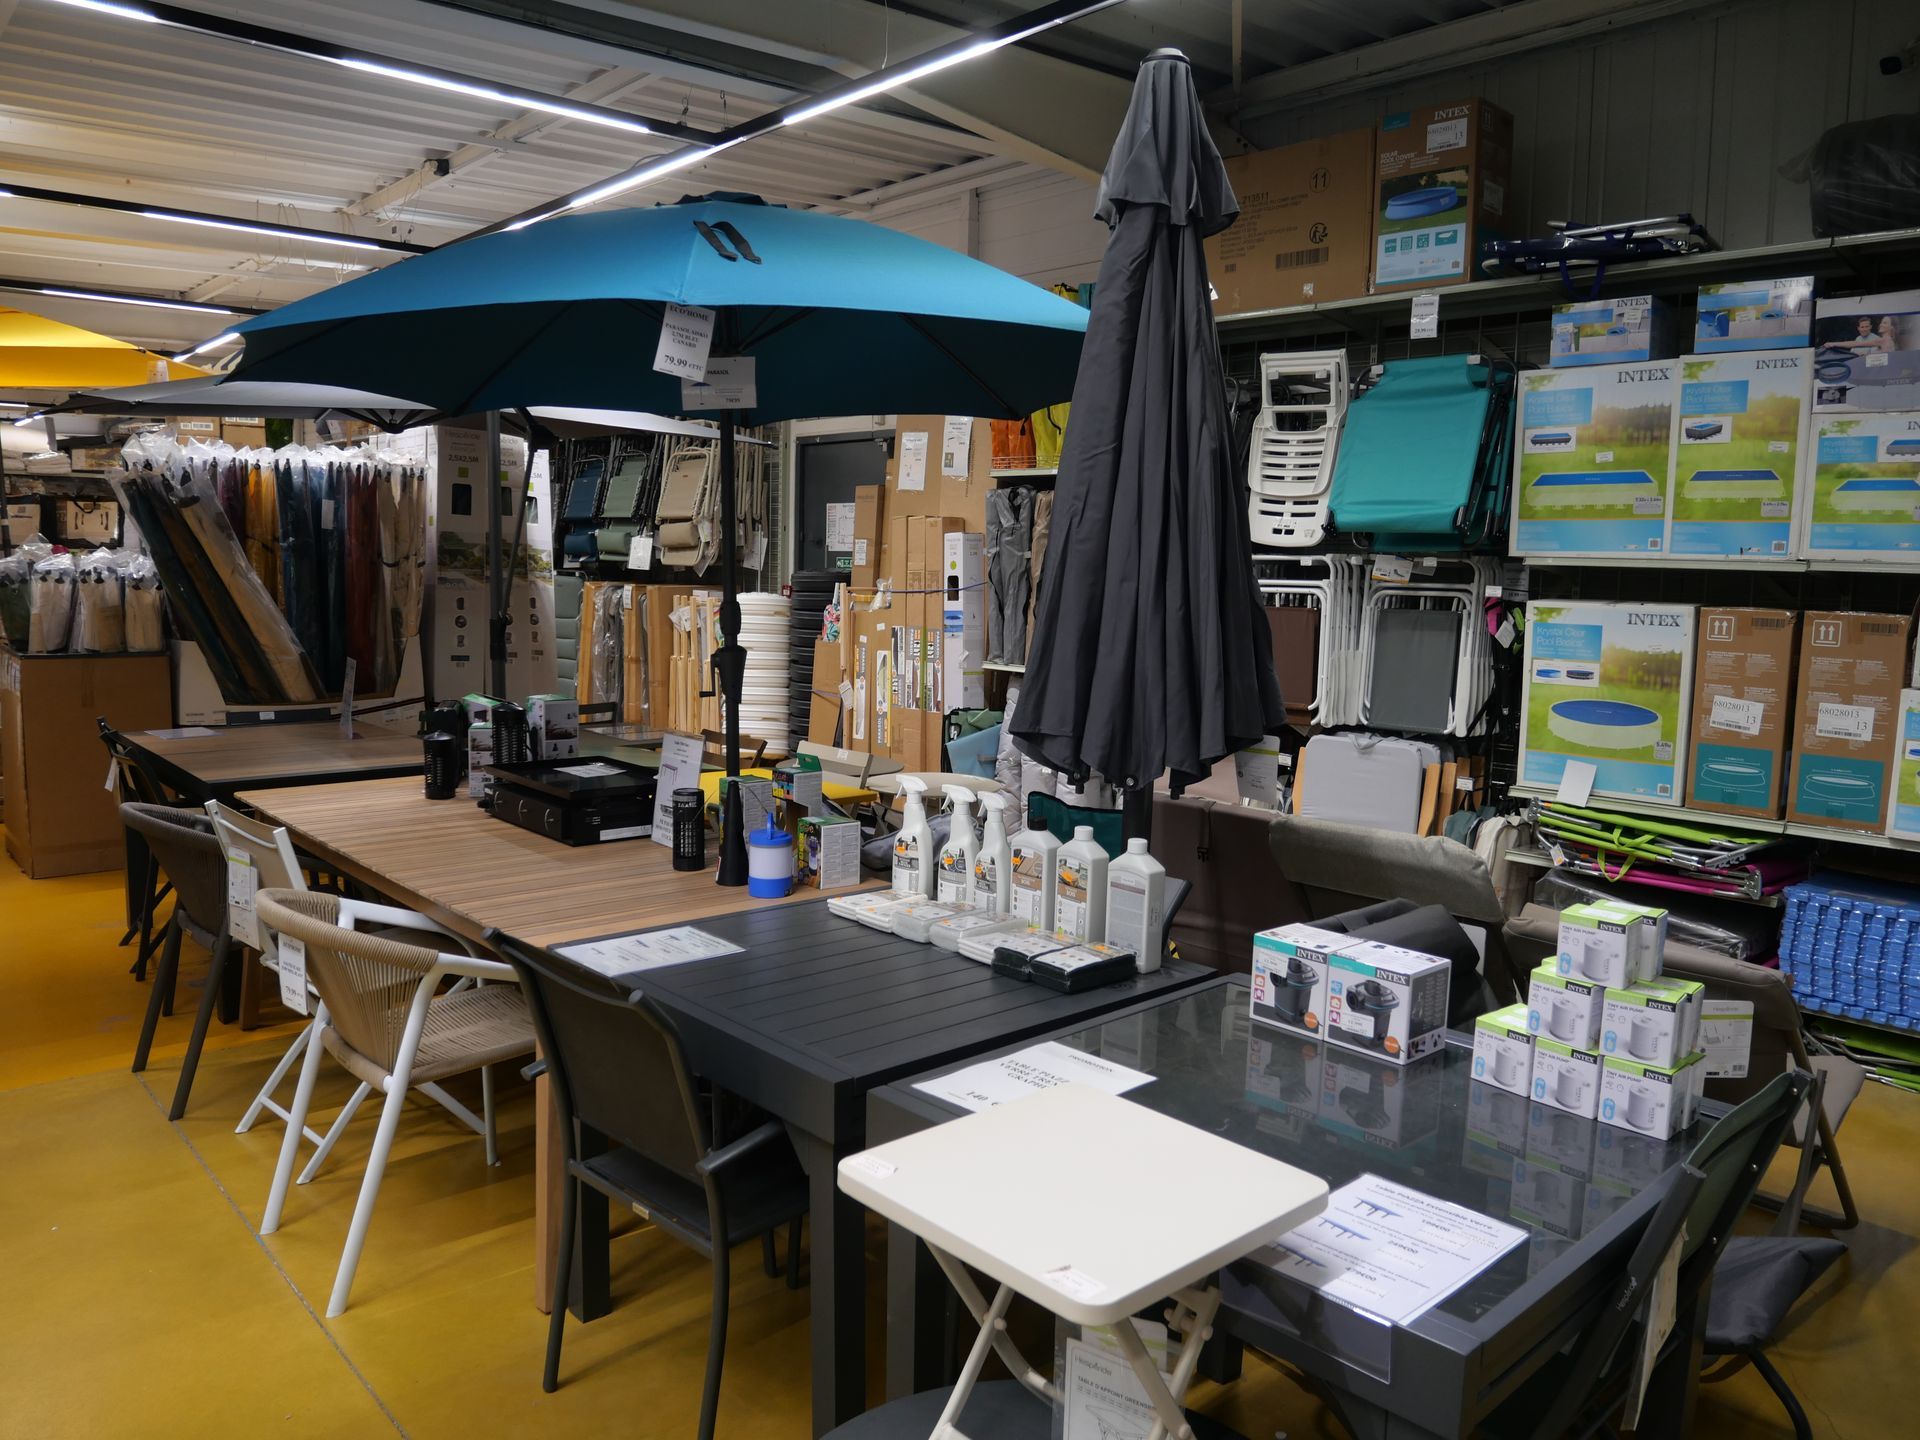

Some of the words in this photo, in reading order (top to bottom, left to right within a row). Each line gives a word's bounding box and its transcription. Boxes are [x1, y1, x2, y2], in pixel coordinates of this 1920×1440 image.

[1434, 105, 1470, 120] INTEX
[1312, 171, 1327, 189] 11
[1773, 278, 1812, 289] INTEX
[1616, 298, 1649, 308] INTEX
[665, 323, 690, 335] PARASOL
[1756, 358, 1799, 370] INTEX
[1617, 368, 1671, 384] INTEX
[1626, 613, 1681, 628] INTEX
[1714, 700, 1750, 713] 68028013
[1820, 708, 1860, 718] 68028013
[1745, 716, 1756, 725] 13
[1856, 721, 1868, 731] 13
[1600, 924, 1624, 934] INTEX
[1297, 948, 1325, 962] INTEX
[1376, 970, 1406, 984] INTEX
[1567, 984, 1590, 995] INTEX
[1648, 1002, 1674, 1012] INTEX
[1508, 1030, 1529, 1043] INTEX
[1573, 1050, 1596, 1064] INTEX
[1008, 1059, 1039, 1074] TABLE
[1646, 1071, 1670, 1083] INTEX
[1375, 1184, 1396, 1195] Table
[1397, 1190, 1426, 1204] PIAZZA
[1426, 1201, 1468, 1220] Extensible
[1469, 1218, 1494, 1230] Verre
[1078, 1375, 1094, 1387] TABLE
[1094, 1382, 1124, 1399] D'APPOINT
